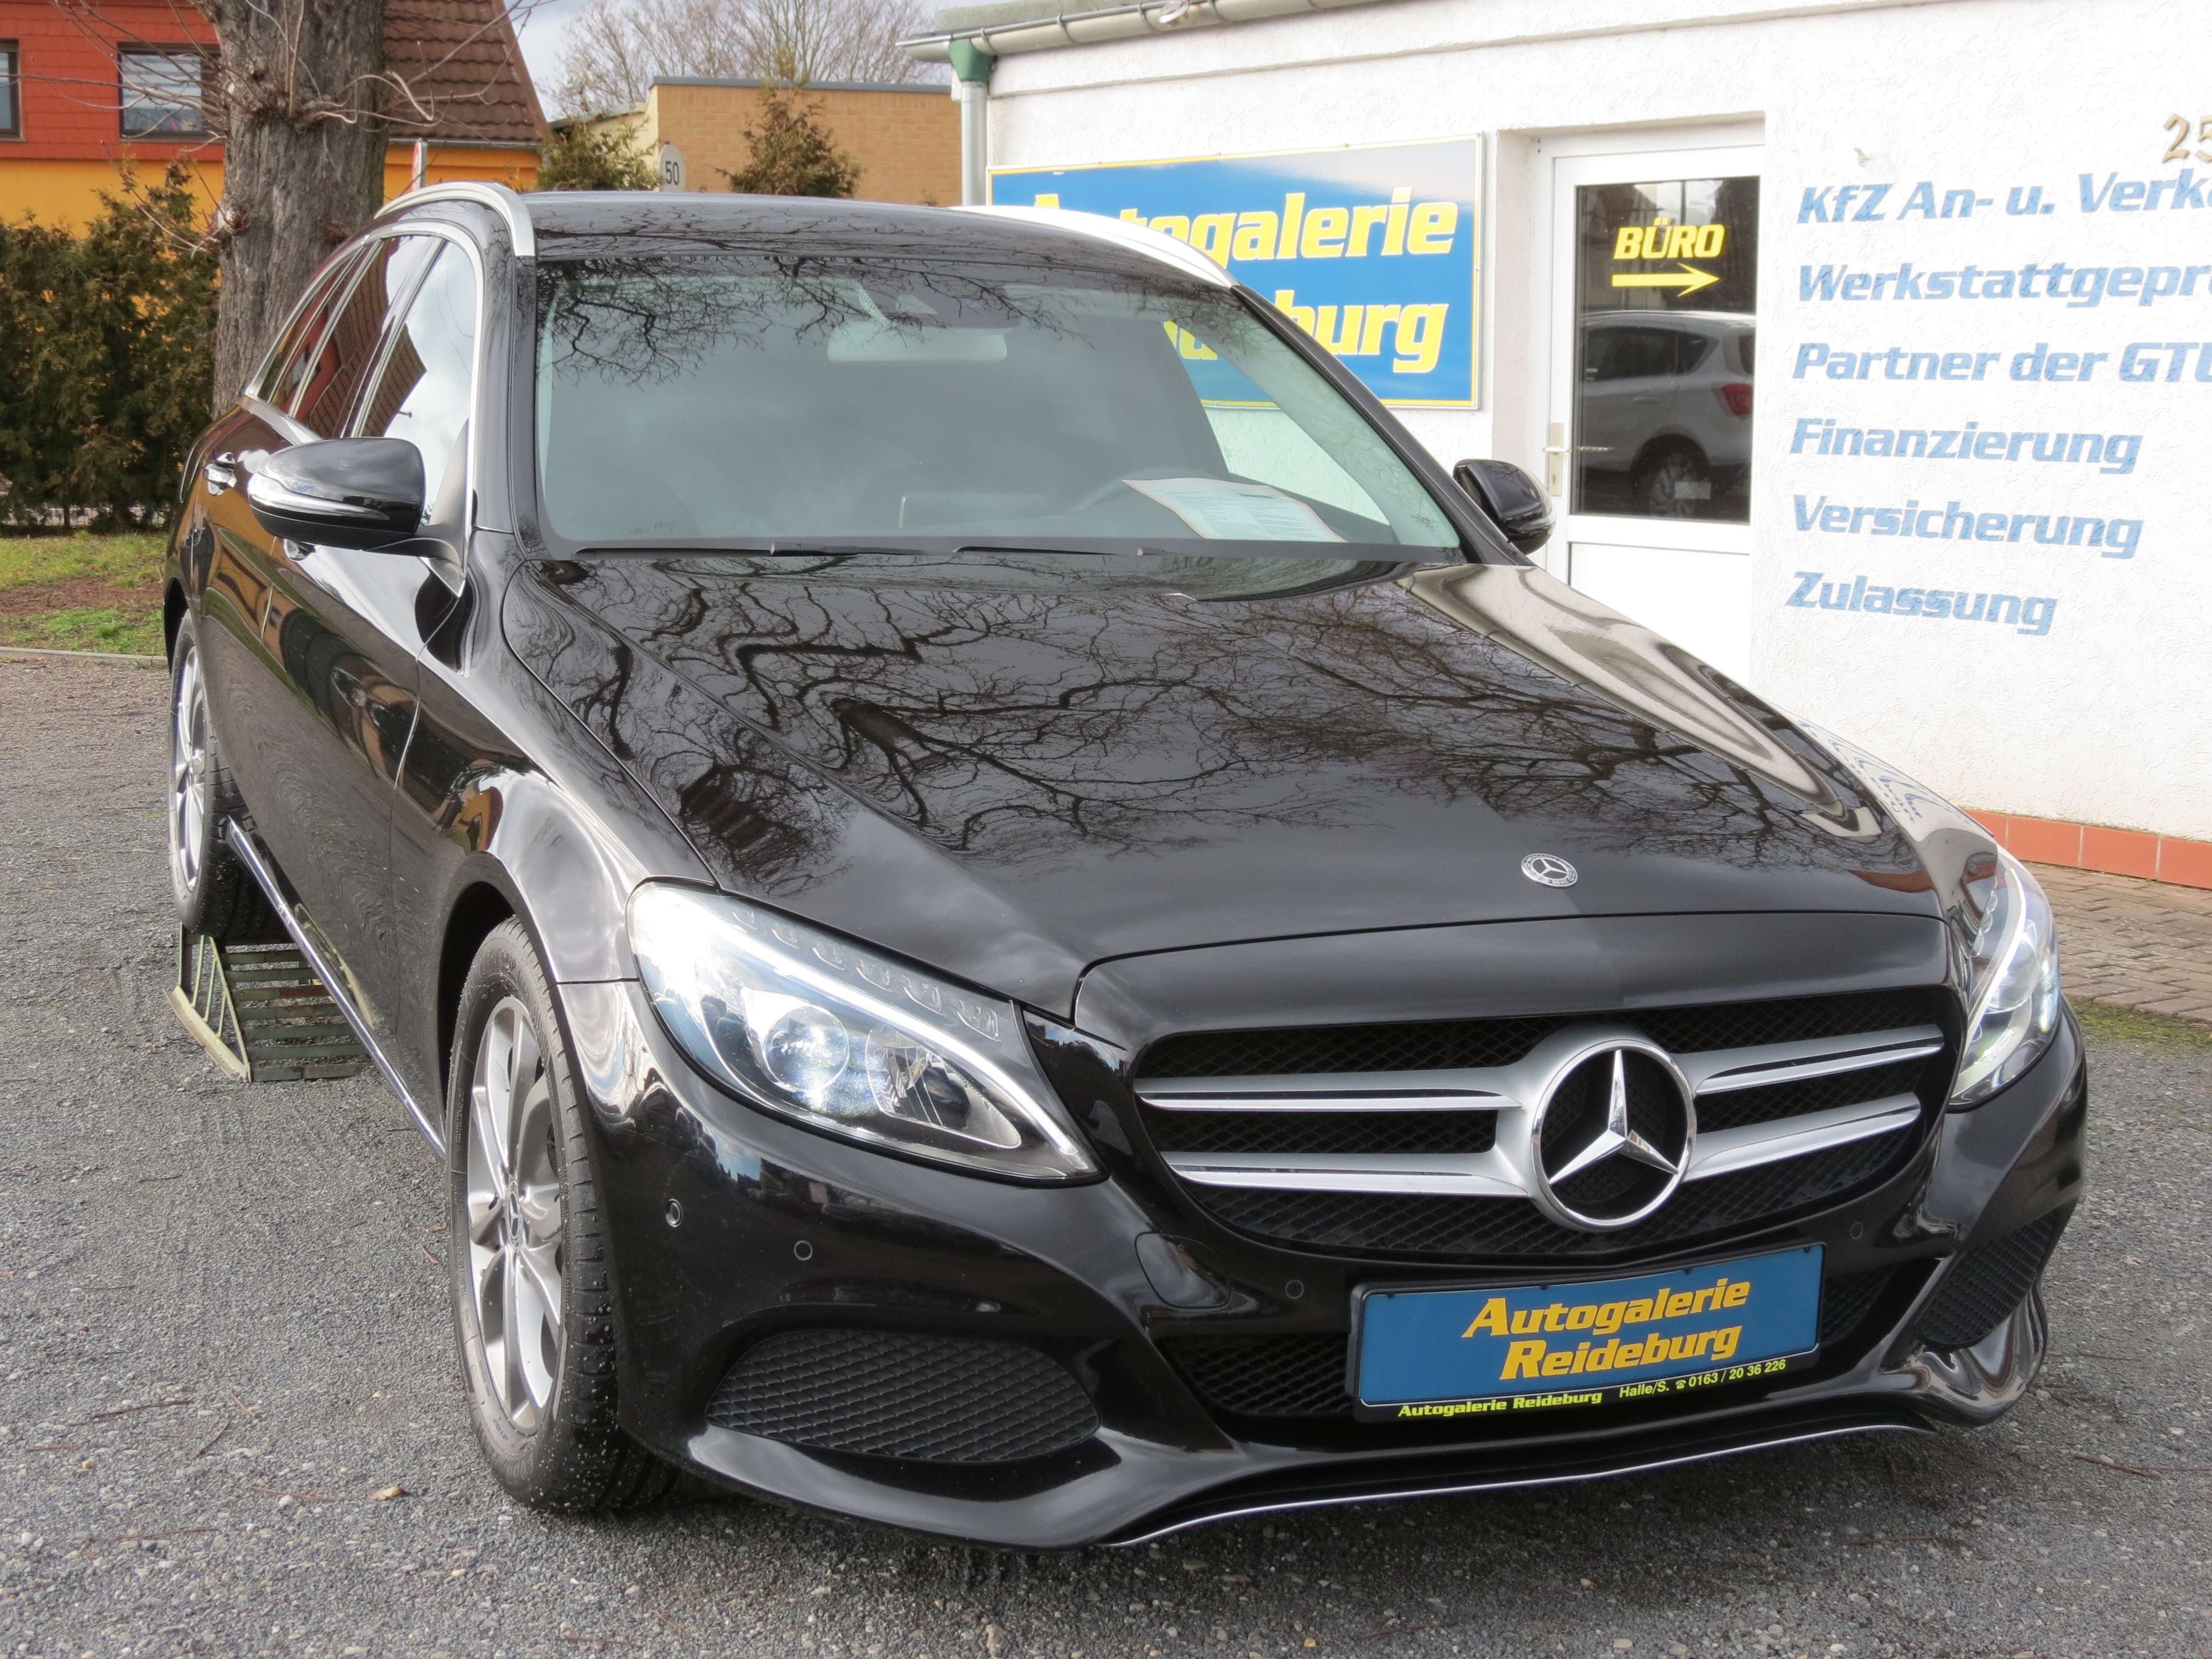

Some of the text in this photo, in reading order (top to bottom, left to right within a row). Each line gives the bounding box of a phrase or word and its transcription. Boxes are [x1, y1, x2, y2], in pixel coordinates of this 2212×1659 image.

[665, 160, 680, 186] 50
[1797, 168, 2212, 224] KfZ An- u. Verk
[1613, 218, 1725, 260] BÜRO
[1799, 262, 2212, 308] Werkstattgepr
[1793, 343, 2000, 380] Partner
[2010, 342, 2109, 382] der
[1790, 418, 2143, 474] Finanzierung
[1793, 495, 2143, 559] Versicherung
[1785, 572, 2058, 635] Zulassung
[1462, 1278, 1751, 1338] Autogalerie
[1499, 1325, 1743, 1380] Reideburg
[1397, 1400, 1507, 1417] Autogalerie
[1513, 1392, 1603, 1409] Reideburg
[1619, 1381, 1670, 1399] Halle/S.
[1689, 1373, 1718, 1387] 0163
[1729, 1368, 1745, 1380] 20
[1747, 1364, 1762, 1376] 36
[1765, 1359, 1786, 1373] 226
